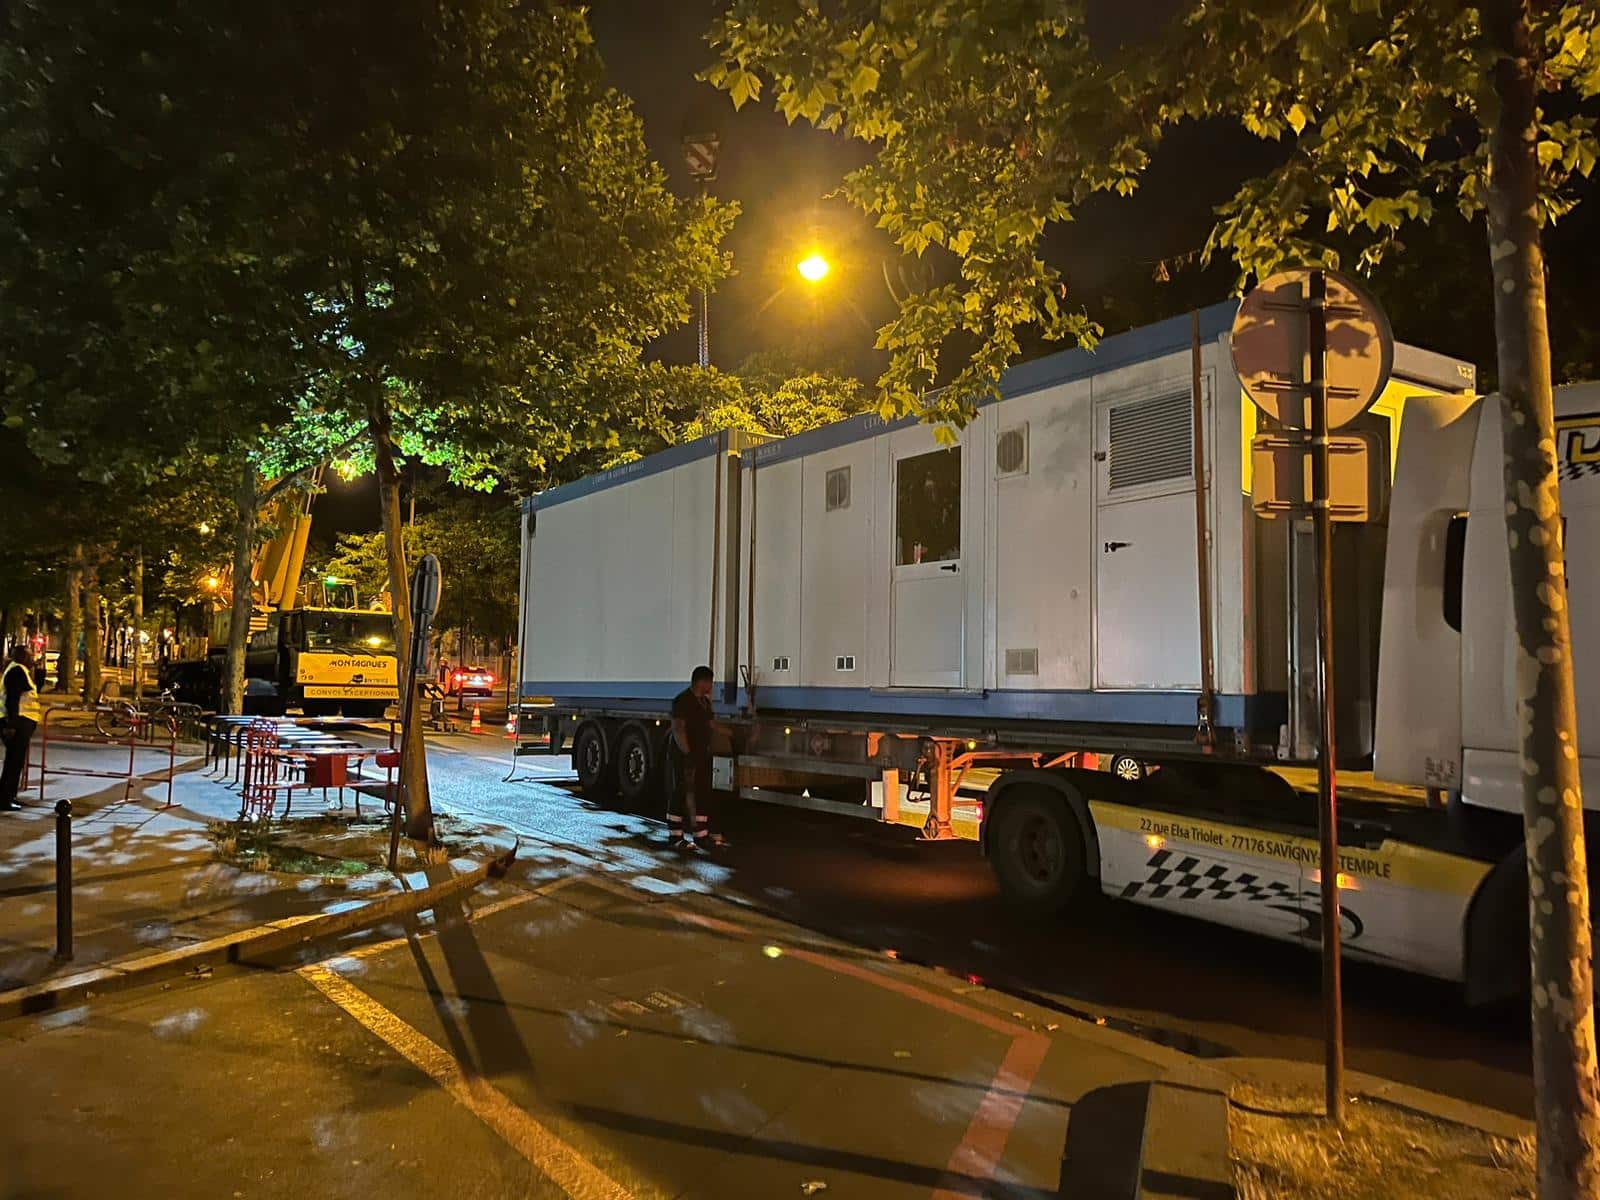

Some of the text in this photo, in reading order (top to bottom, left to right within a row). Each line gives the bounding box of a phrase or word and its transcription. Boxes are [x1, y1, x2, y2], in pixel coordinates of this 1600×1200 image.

[1140, 818, 1152, 831] 22
[1153, 823, 1170, 834] rue
[1171, 824, 1190, 839] Elsa
[1191, 827, 1223, 846] Triolet
[1231, 835, 1265, 853] 77176
